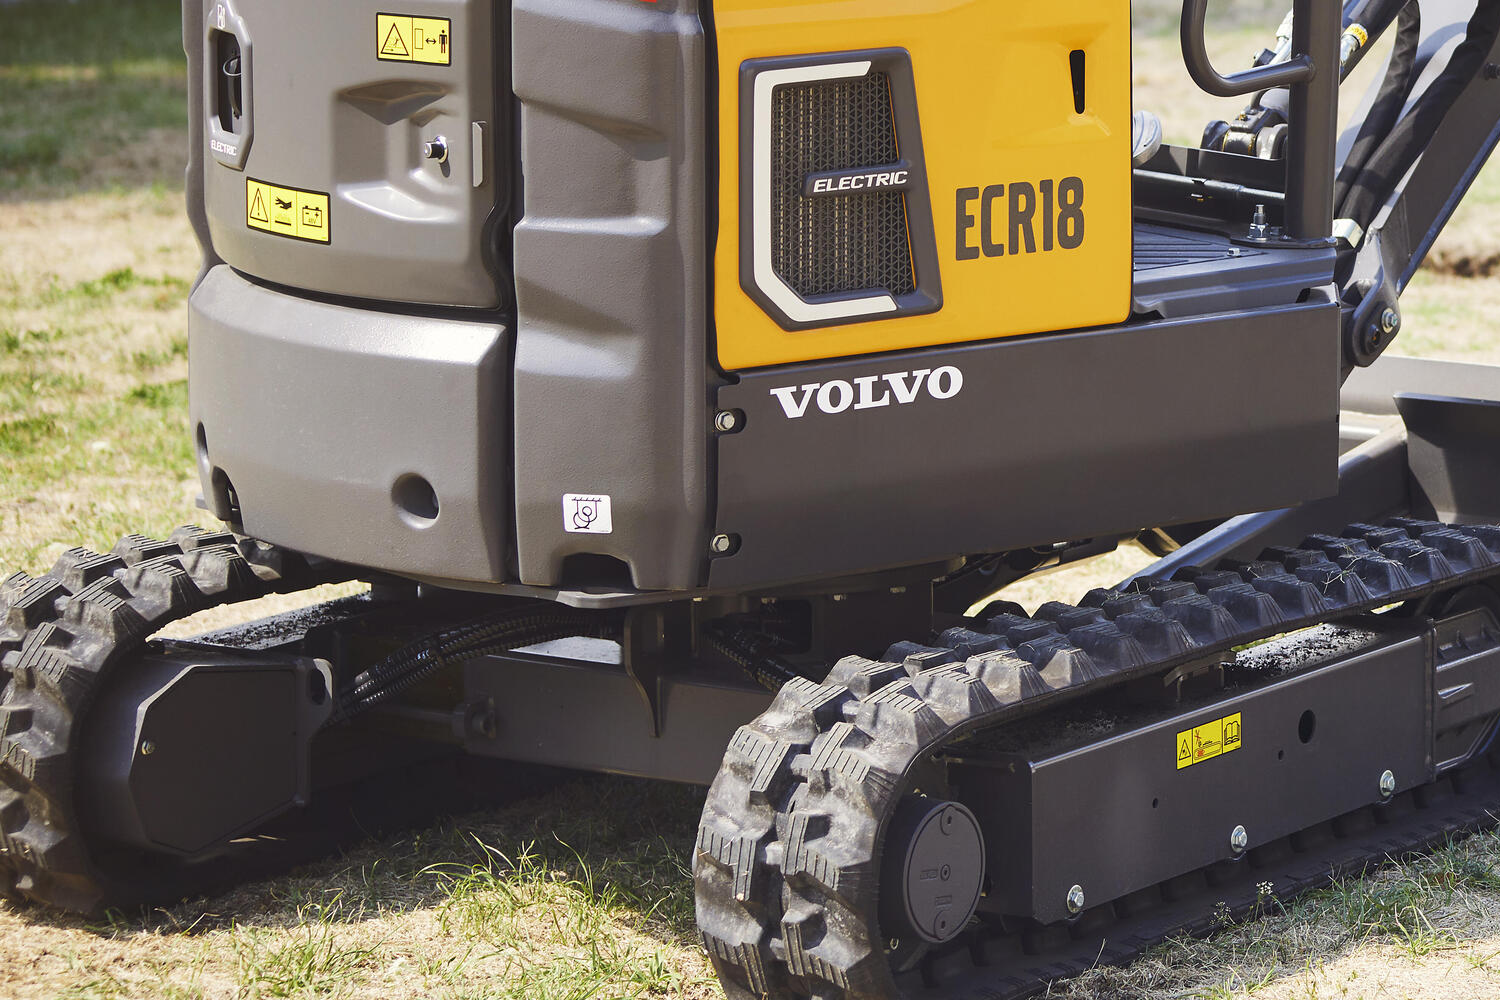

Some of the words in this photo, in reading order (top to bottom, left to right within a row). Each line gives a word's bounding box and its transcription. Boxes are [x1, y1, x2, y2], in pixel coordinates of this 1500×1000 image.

[211, 140, 237, 156] ELECTRIC
[813, 170, 908, 193] ELECTRIC
[955, 176, 1085, 260] ECR18
[770, 365, 963, 419] VOLVO
